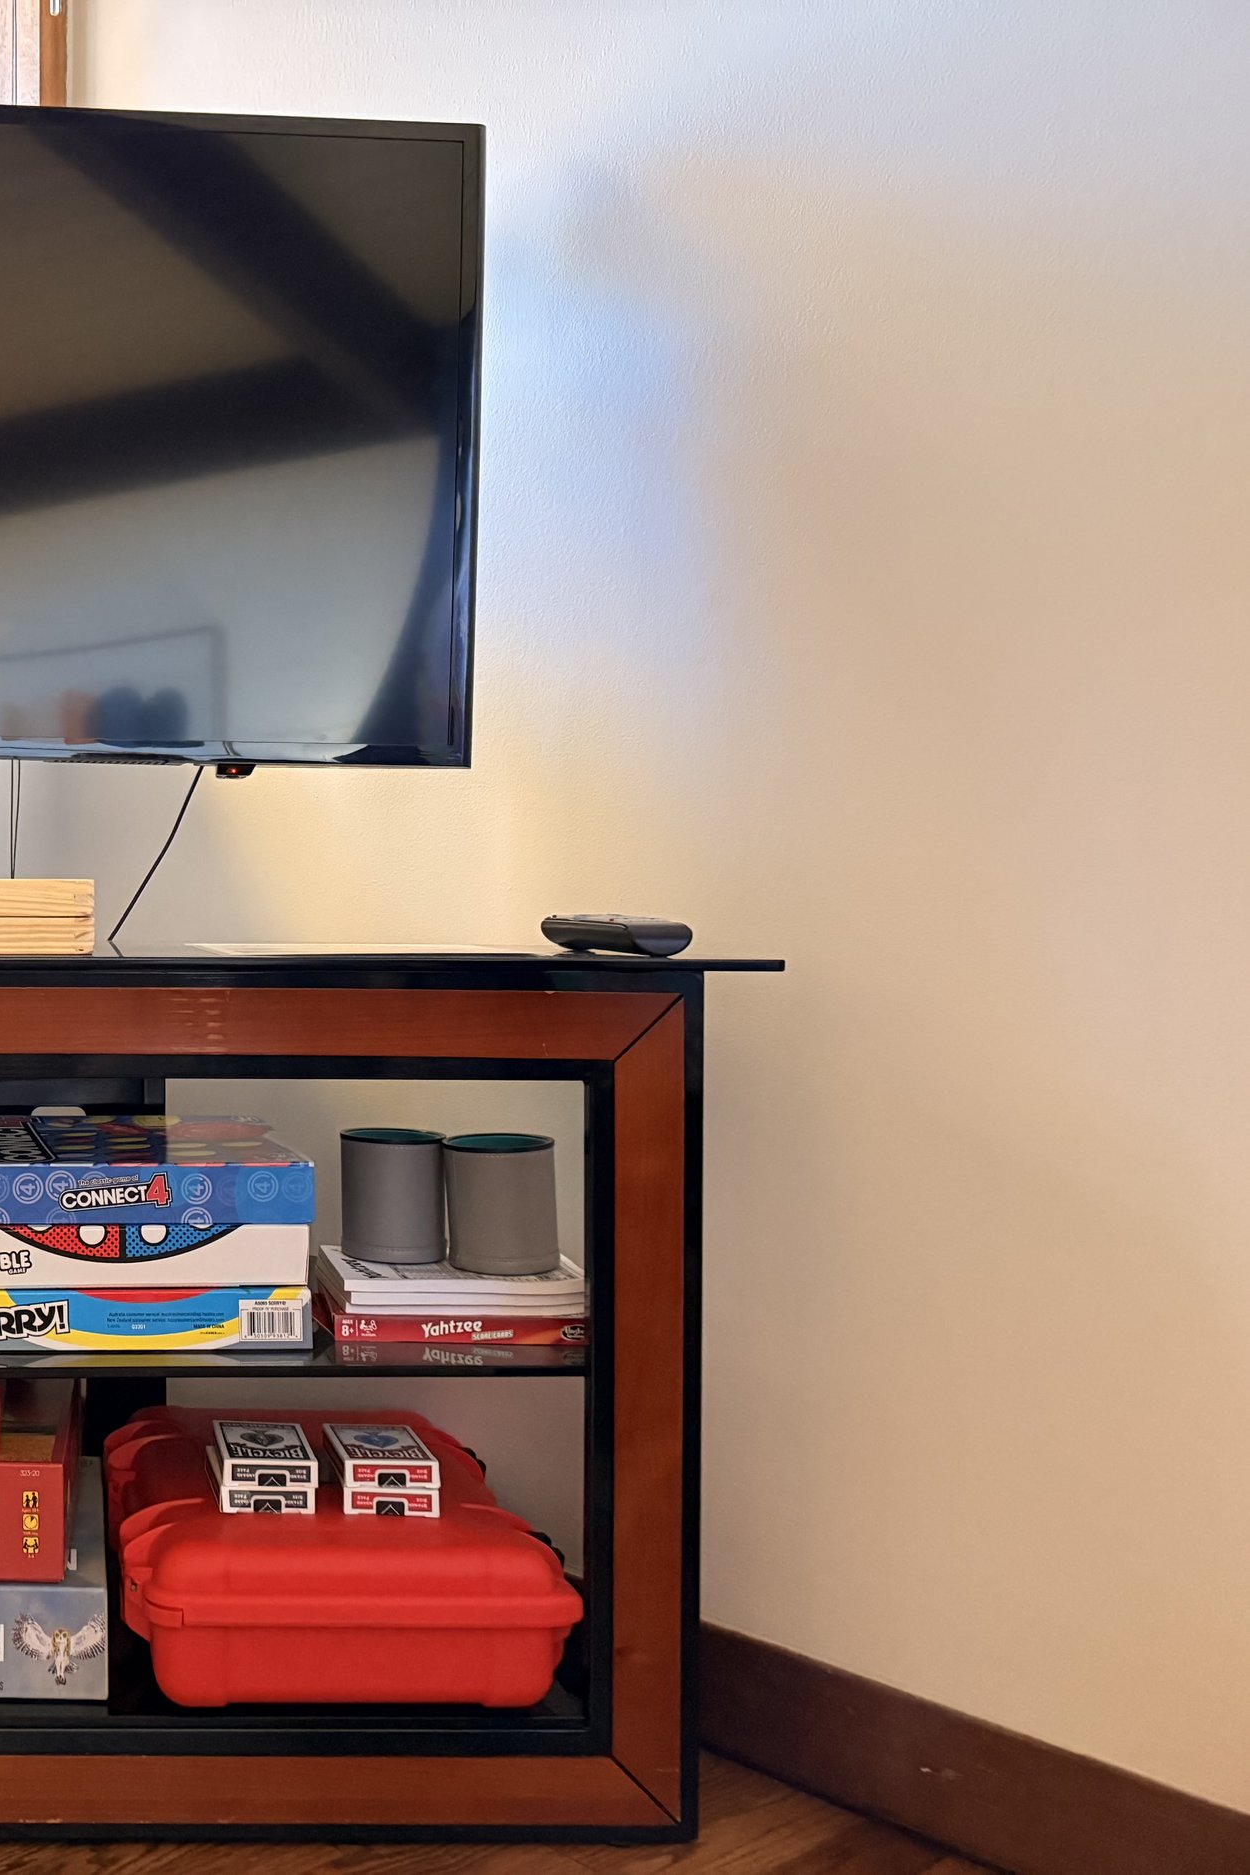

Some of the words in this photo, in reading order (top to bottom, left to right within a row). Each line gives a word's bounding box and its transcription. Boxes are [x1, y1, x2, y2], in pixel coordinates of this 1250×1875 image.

[61, 1185, 148, 1209] CONNECT
[146, 1175, 169, 1205] 4
[341, 1324, 354, 1337] 8+
[421, 1320, 483, 1338] Yahtzee
[230, 1444, 305, 1459] BICYCLE
[346, 1446, 423, 1459] BICYCLE
